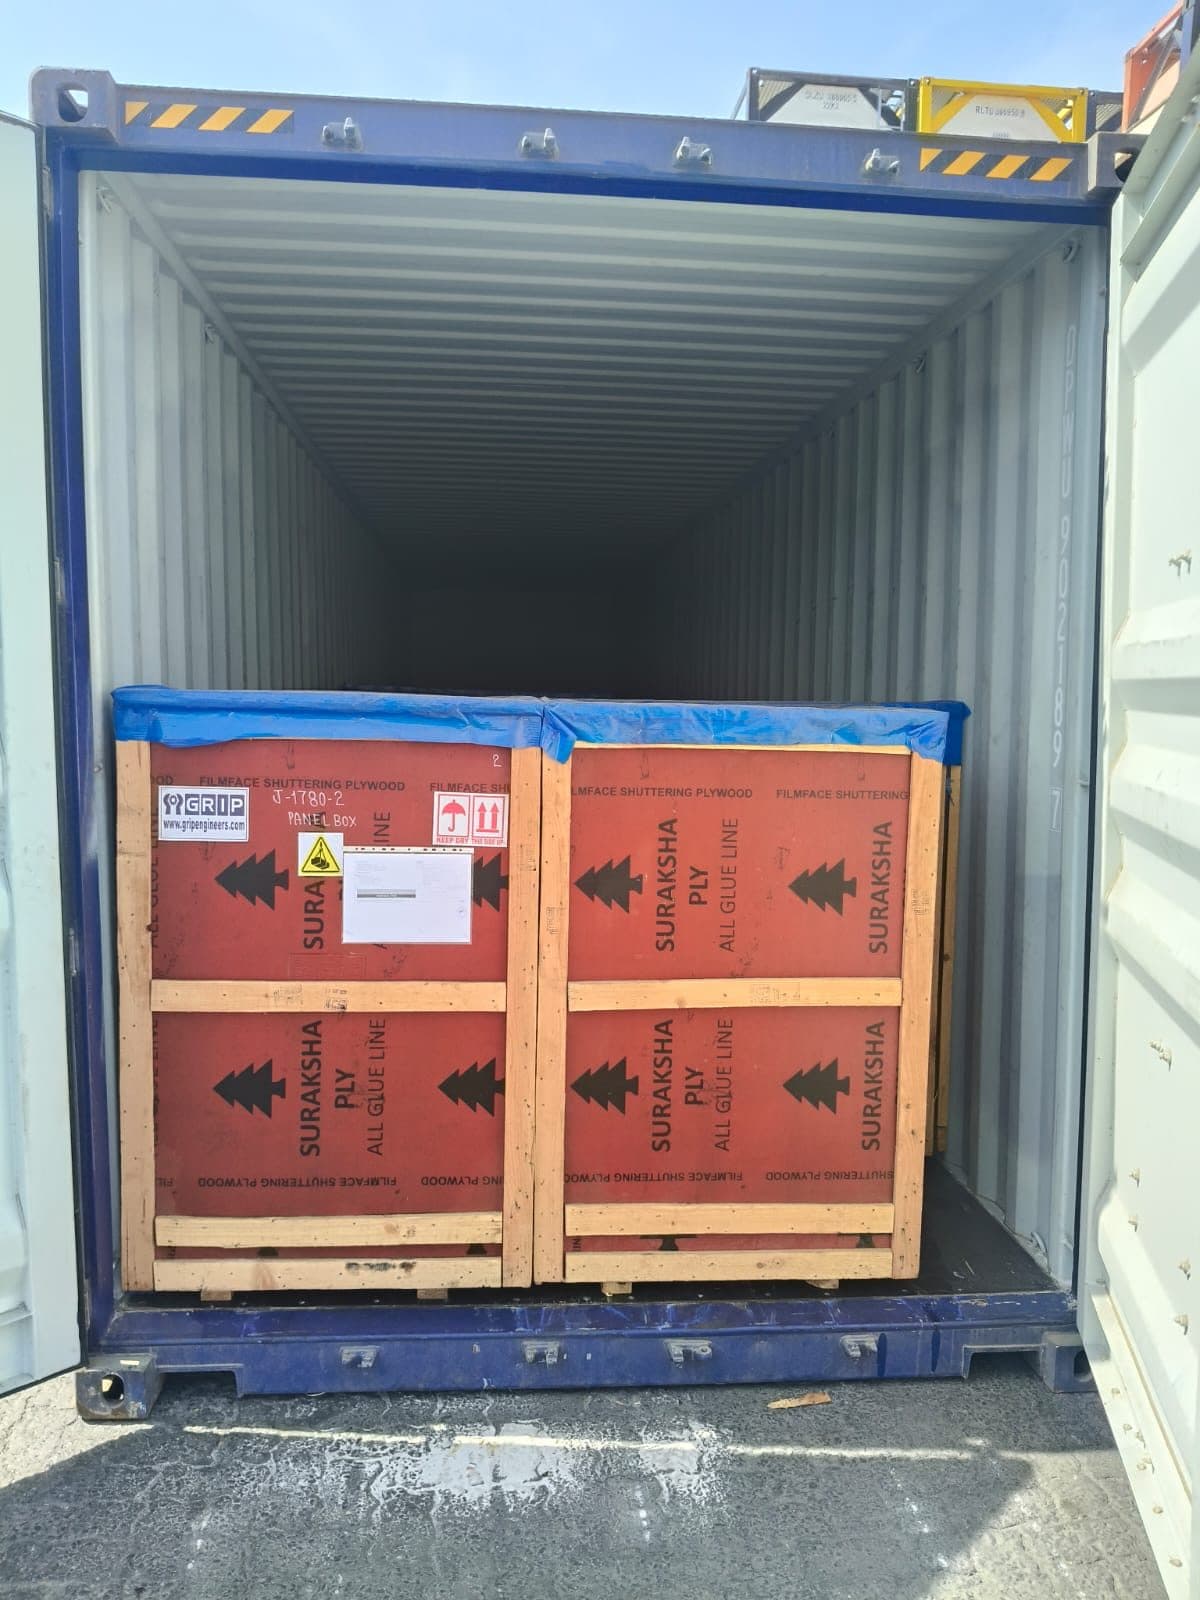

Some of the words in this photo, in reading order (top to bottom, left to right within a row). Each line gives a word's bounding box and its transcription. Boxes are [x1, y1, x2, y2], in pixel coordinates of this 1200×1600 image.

[492, 753, 503, 768] 2
[200, 776, 260, 788] FILMFACE
[264, 778, 341, 790] SHUTTERING
[345, 780, 406, 791] PLYWOOD
[430, 782, 488, 793] FILMFACE
[620, 787, 693, 797] SHUTTERING
[696, 788, 753, 798] PLYWOOD
[776, 789, 832, 799] FILMFACE
[835, 790, 910, 800] SHUTTERING
[185, 796, 244, 814] GRIP
[272, 789, 345, 807] J-1780-2
[163, 818, 245, 833] www.gripengineers.com
[288, 811, 331, 827] PANEL
[334, 813, 357, 827] BOX
[722, 818, 739, 859] LINE
[656, 817, 679, 952] SURAKSHA
[689, 865, 709, 906] PLY
[720, 865, 737, 915] GLUE
[868, 821, 893, 955] SURAKSHA
[719, 920, 735, 952] ALL
[370, 1019, 386, 1060] LINE
[717, 1019, 733, 1059] LINE
[300, 1020, 323, 1158] SURAKSHA
[334, 1068, 356, 1109] PLY
[369, 1068, 385, 1119] GLUE
[651, 1018, 674, 1153] SURAKSHA
[684, 1066, 705, 1106] PLY
[715, 1066, 732, 1113] GLUE
[861, 1020, 885, 1152] SURAKSHA
[367, 1124, 384, 1156] ALL
[714, 1118, 730, 1152] ALL
[198, 1178, 256, 1189] PLYWOOD
[261, 1178, 336, 1188] SHUTTERING
[340, 1177, 397, 1187] FILMFACE
[421, 1176, 477, 1186] PLYWOOD
[614, 1172, 684, 1183] SHUTTERING
[688, 1171, 743, 1182] FILMFACE
[766, 1172, 821, 1182] PLYWOOD
[824, 1170, 894, 1181] SHUTTERING
